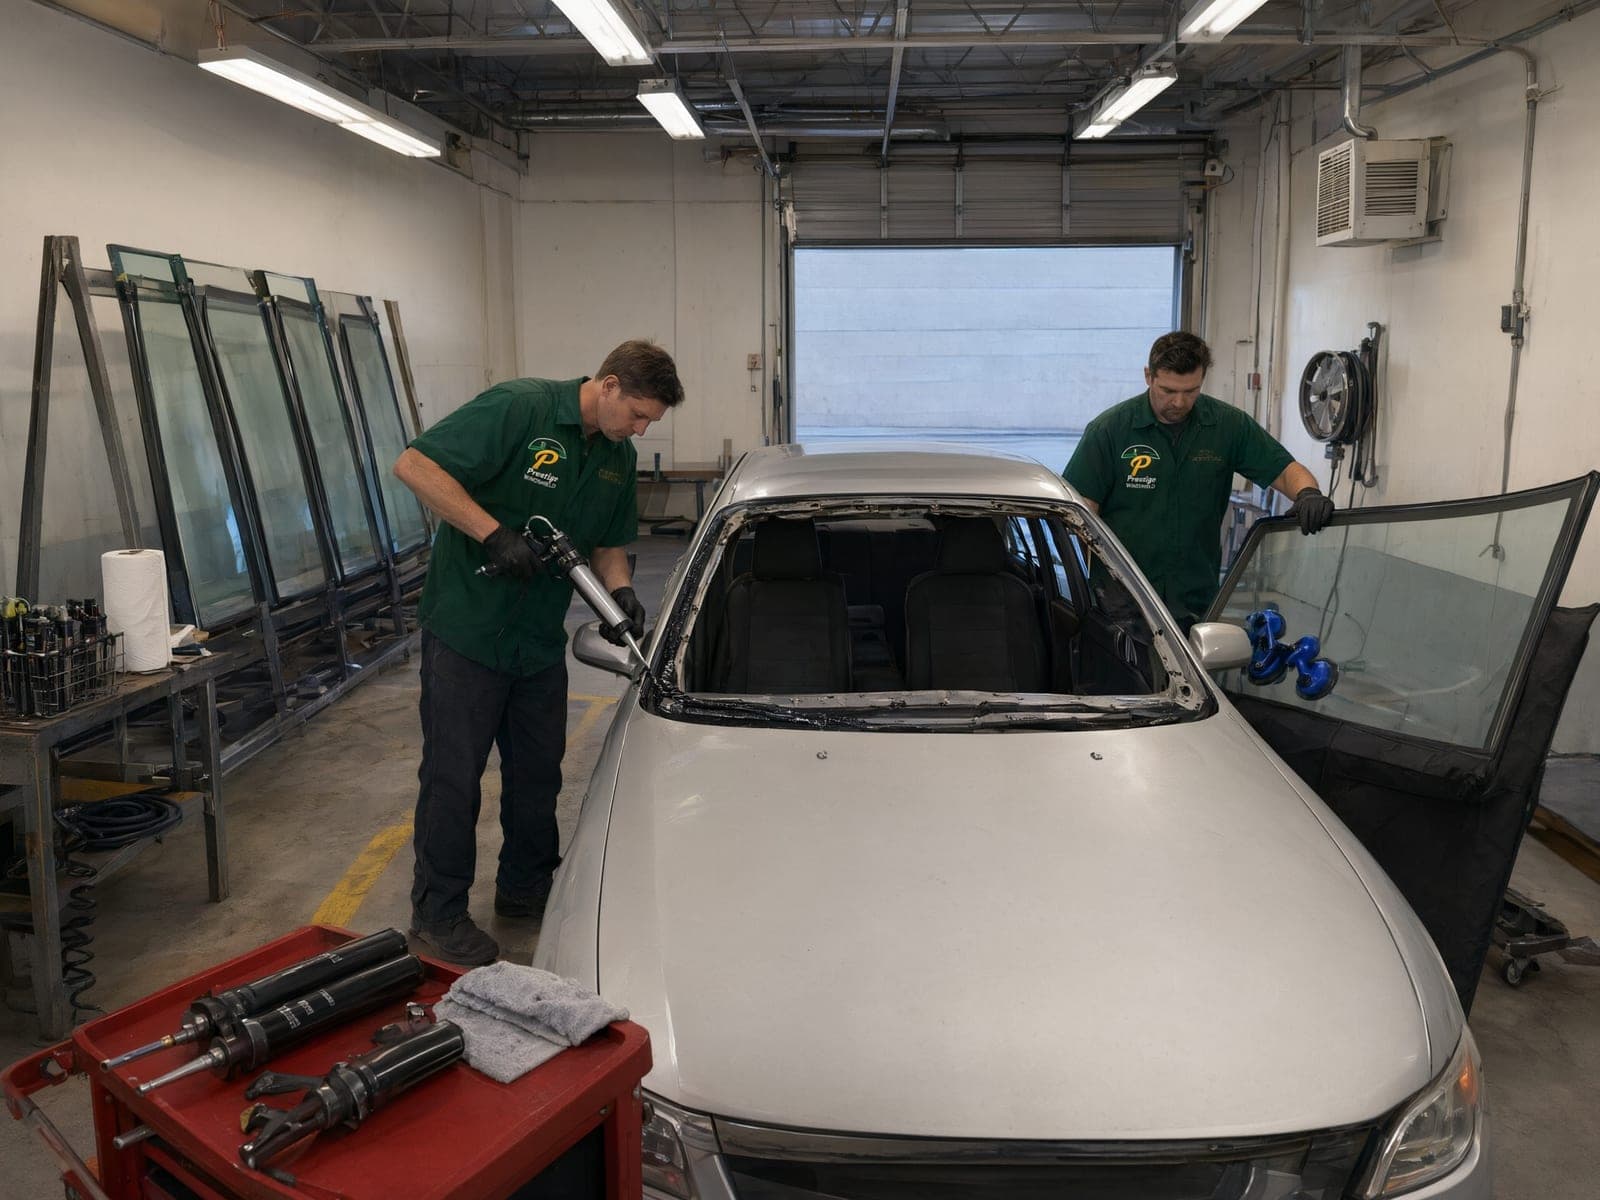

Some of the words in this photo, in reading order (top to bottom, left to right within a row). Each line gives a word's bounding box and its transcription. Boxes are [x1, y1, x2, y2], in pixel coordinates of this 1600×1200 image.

[532, 449, 559, 470] P
[1130, 455, 1152, 477] P
[526, 467, 559, 483] Prestige
